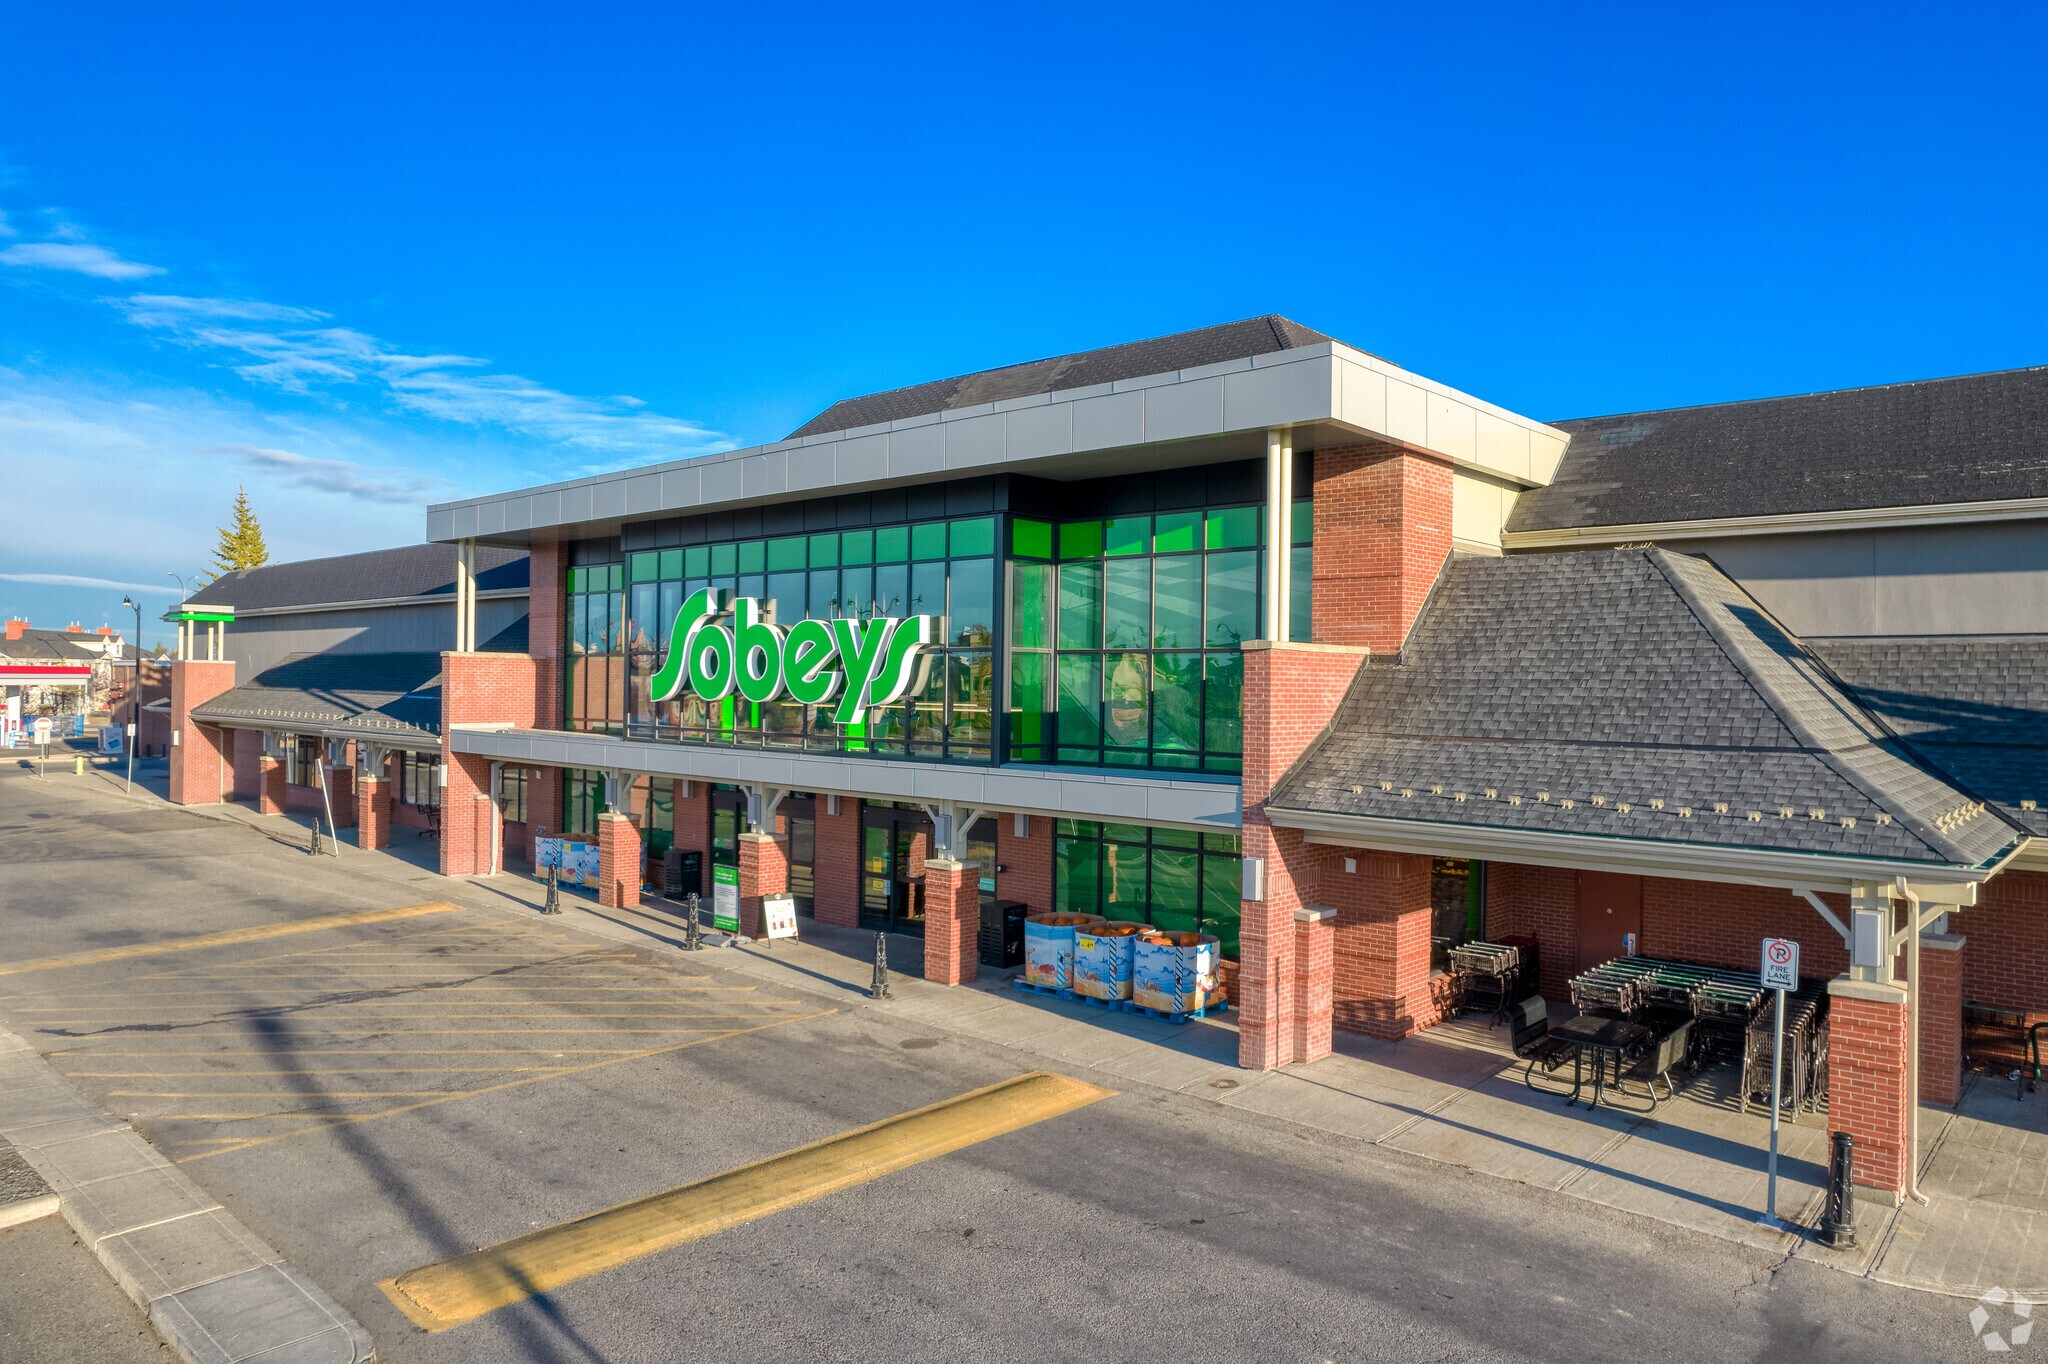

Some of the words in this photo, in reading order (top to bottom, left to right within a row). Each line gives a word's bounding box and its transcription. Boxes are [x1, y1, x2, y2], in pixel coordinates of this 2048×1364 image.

[651, 587, 929, 724] Sobeys
[1770, 965, 1789, 973] FIRE
[1767, 971, 1791, 981] LANE
